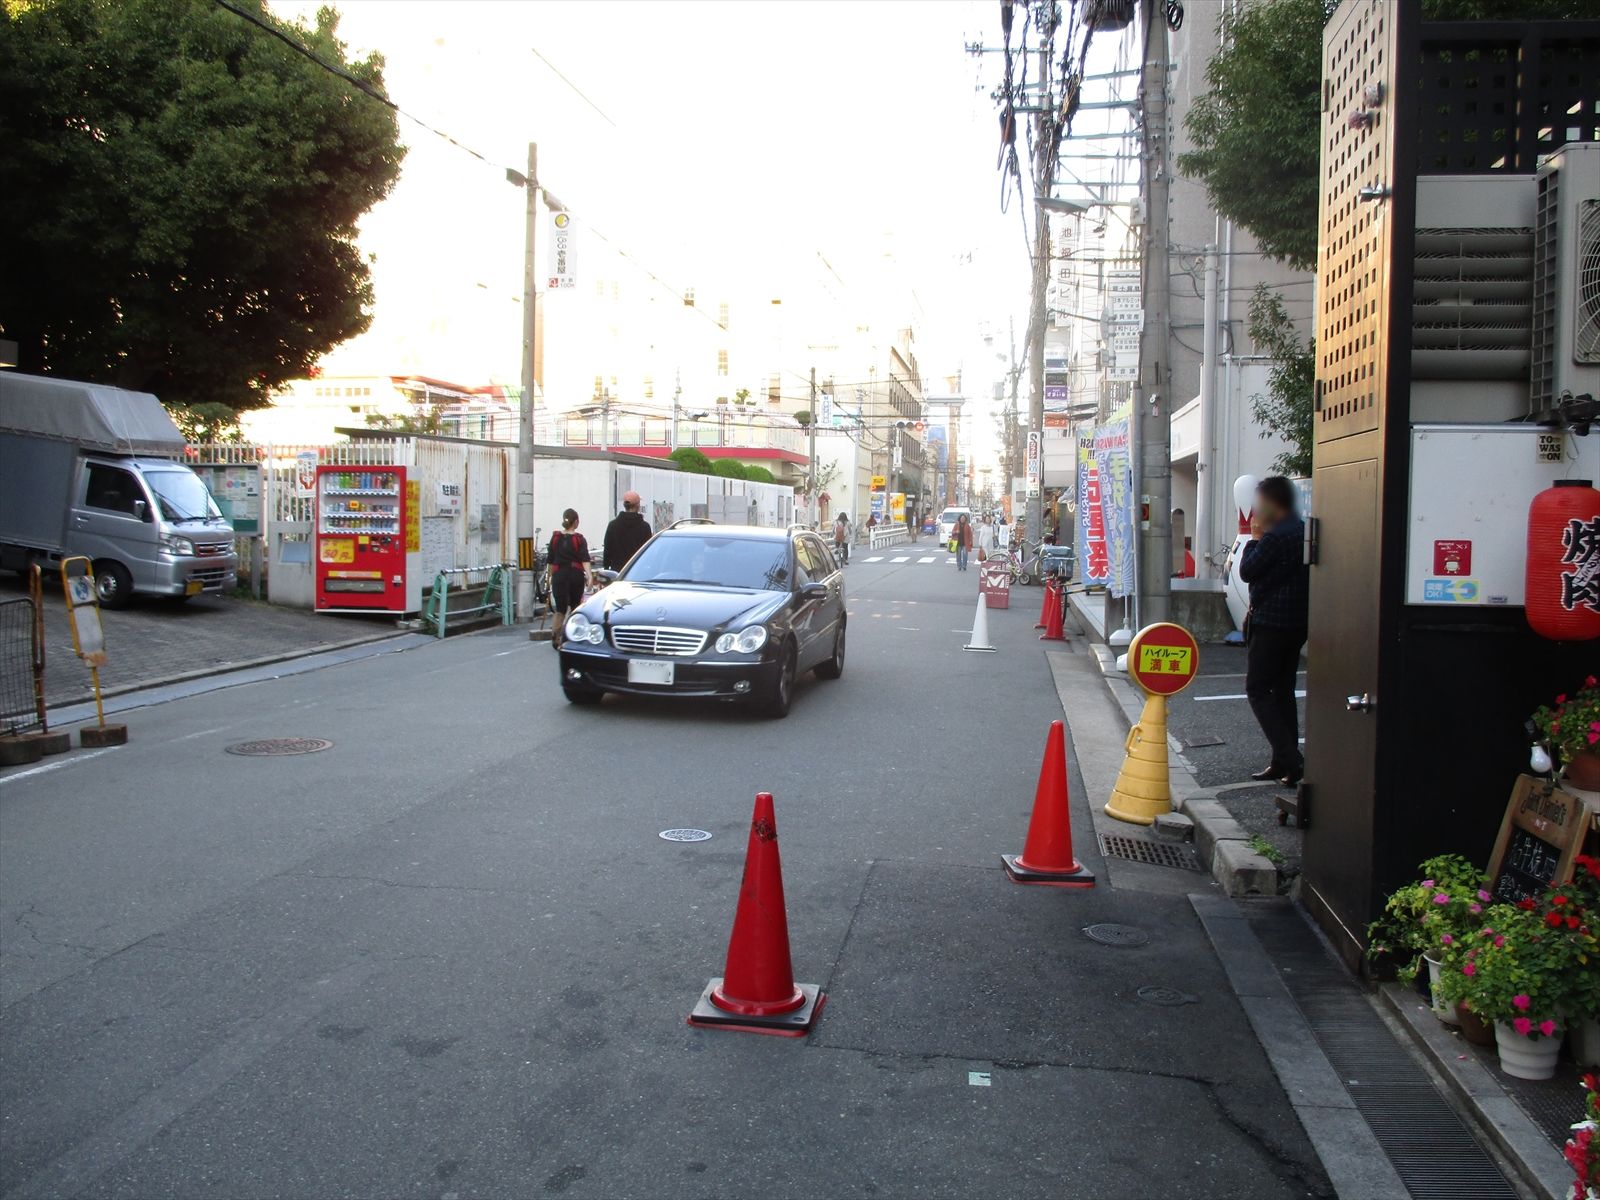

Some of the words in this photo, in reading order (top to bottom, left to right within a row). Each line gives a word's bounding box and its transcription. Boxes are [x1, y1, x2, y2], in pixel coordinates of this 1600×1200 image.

[1539, 444, 1561, 452] WAS
[1560, 515, 1600, 612] 焼肉
[1145, 648, 1187, 659] ハイルーフ
[1150, 658, 1181, 672] 満車
